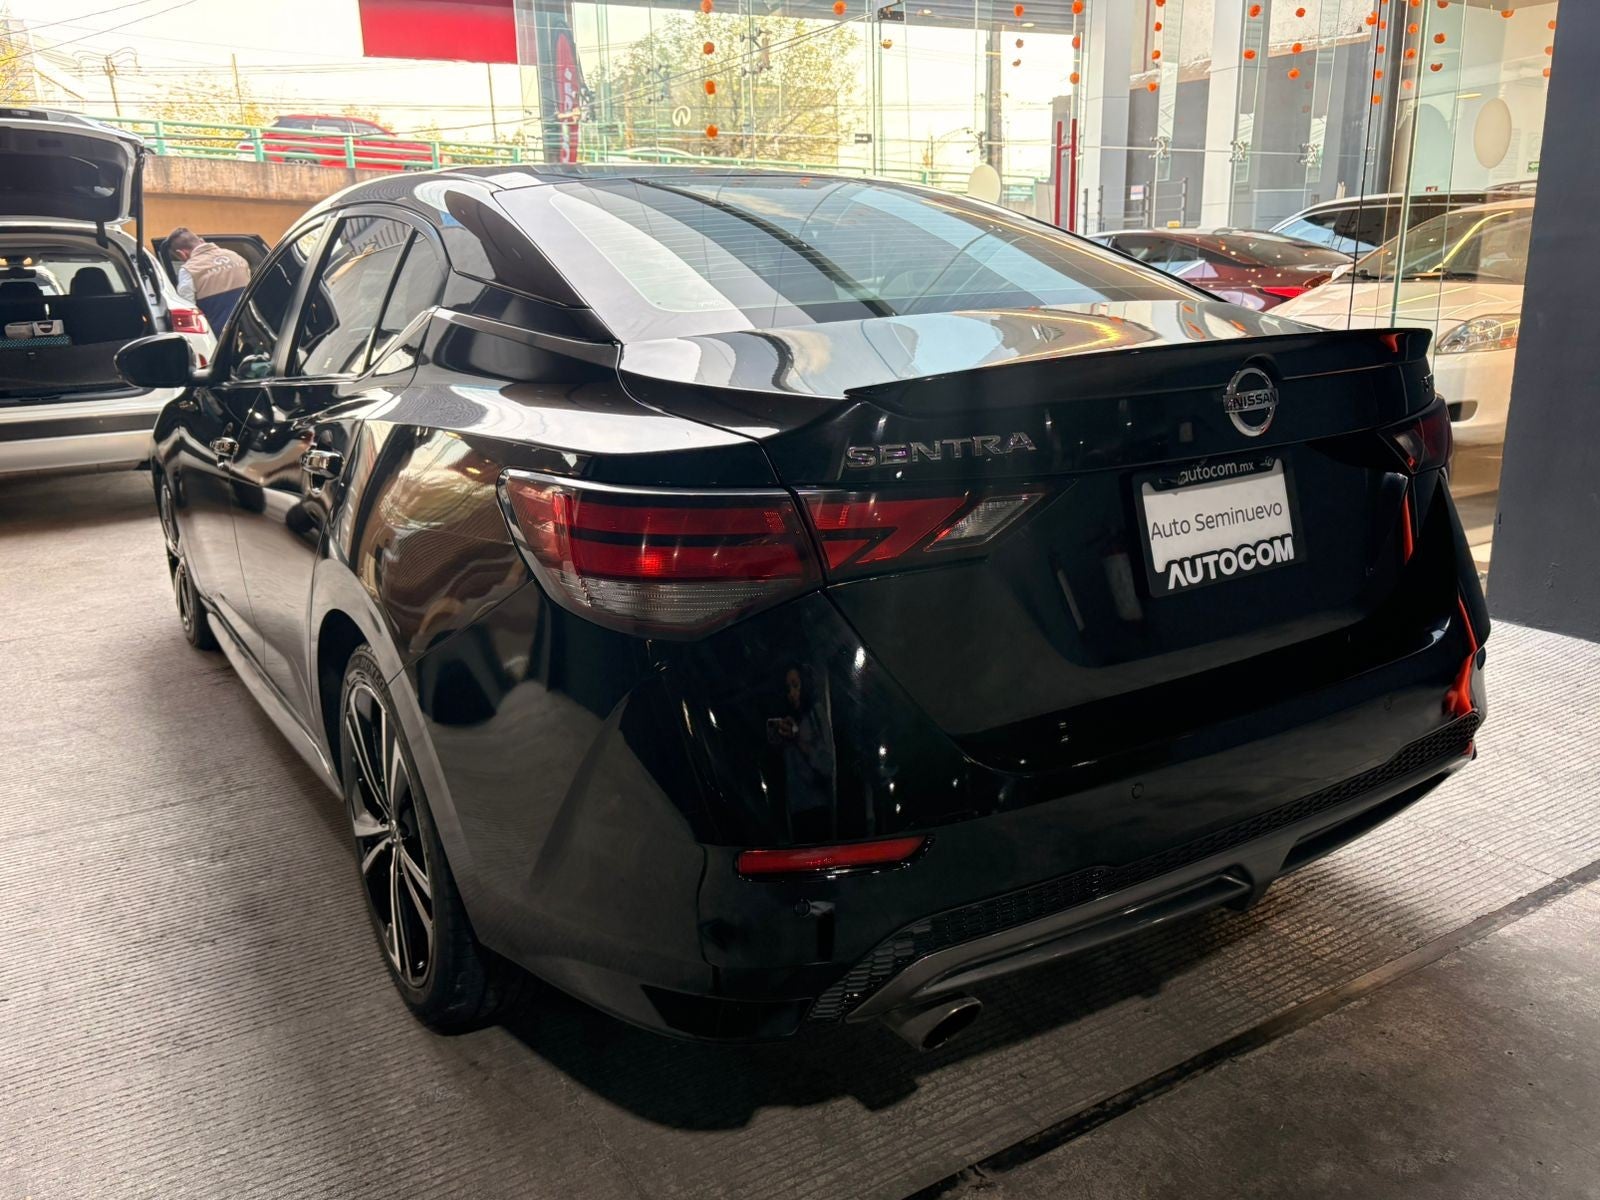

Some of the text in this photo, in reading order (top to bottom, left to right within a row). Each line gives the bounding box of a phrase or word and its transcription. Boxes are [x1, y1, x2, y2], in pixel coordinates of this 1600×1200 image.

[1232, 391, 1277, 409] NISSAN
[846, 432, 1037, 468] SENTRA
[1178, 461, 1255, 485] autocom.mx
[1151, 502, 1283, 541] Auto Seminuevo
[1168, 536, 1295, 590] AUTOCOM
